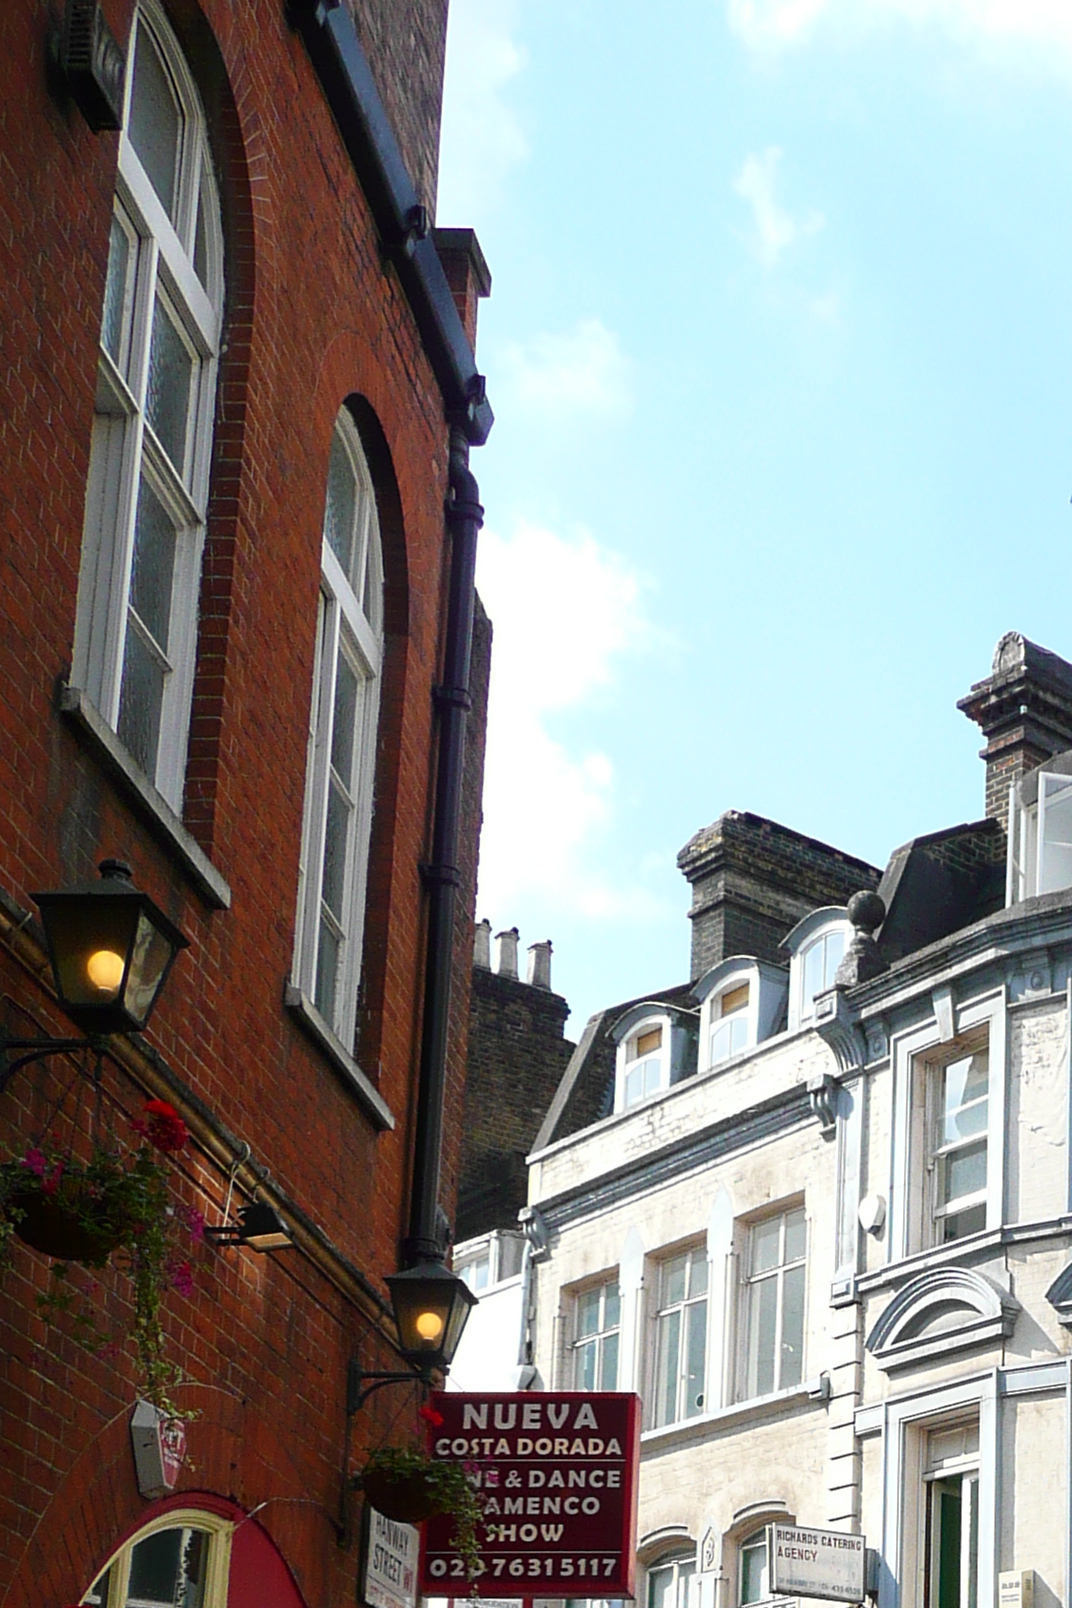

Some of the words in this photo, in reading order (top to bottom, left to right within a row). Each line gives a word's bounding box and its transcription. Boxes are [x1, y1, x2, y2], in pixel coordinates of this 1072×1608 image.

[463, 1402, 598, 1430] NUEVA
[435, 1438, 511, 1456] COSTA
[516, 1437, 622, 1455] DORADA
[505, 1470, 522, 1488] &
[528, 1470, 621, 1488] DANCE
[483, 1496, 600, 1515] AMENCO
[777, 1529, 818, 1546] RICHARDS
[820, 1535, 862, 1552] CATERING
[777, 1545, 818, 1562] AGENCY
[373, 1543, 402, 1587] STREET
[492, 1558, 553, 1577] 7631
[559, 1558, 617, 1577] 5117
